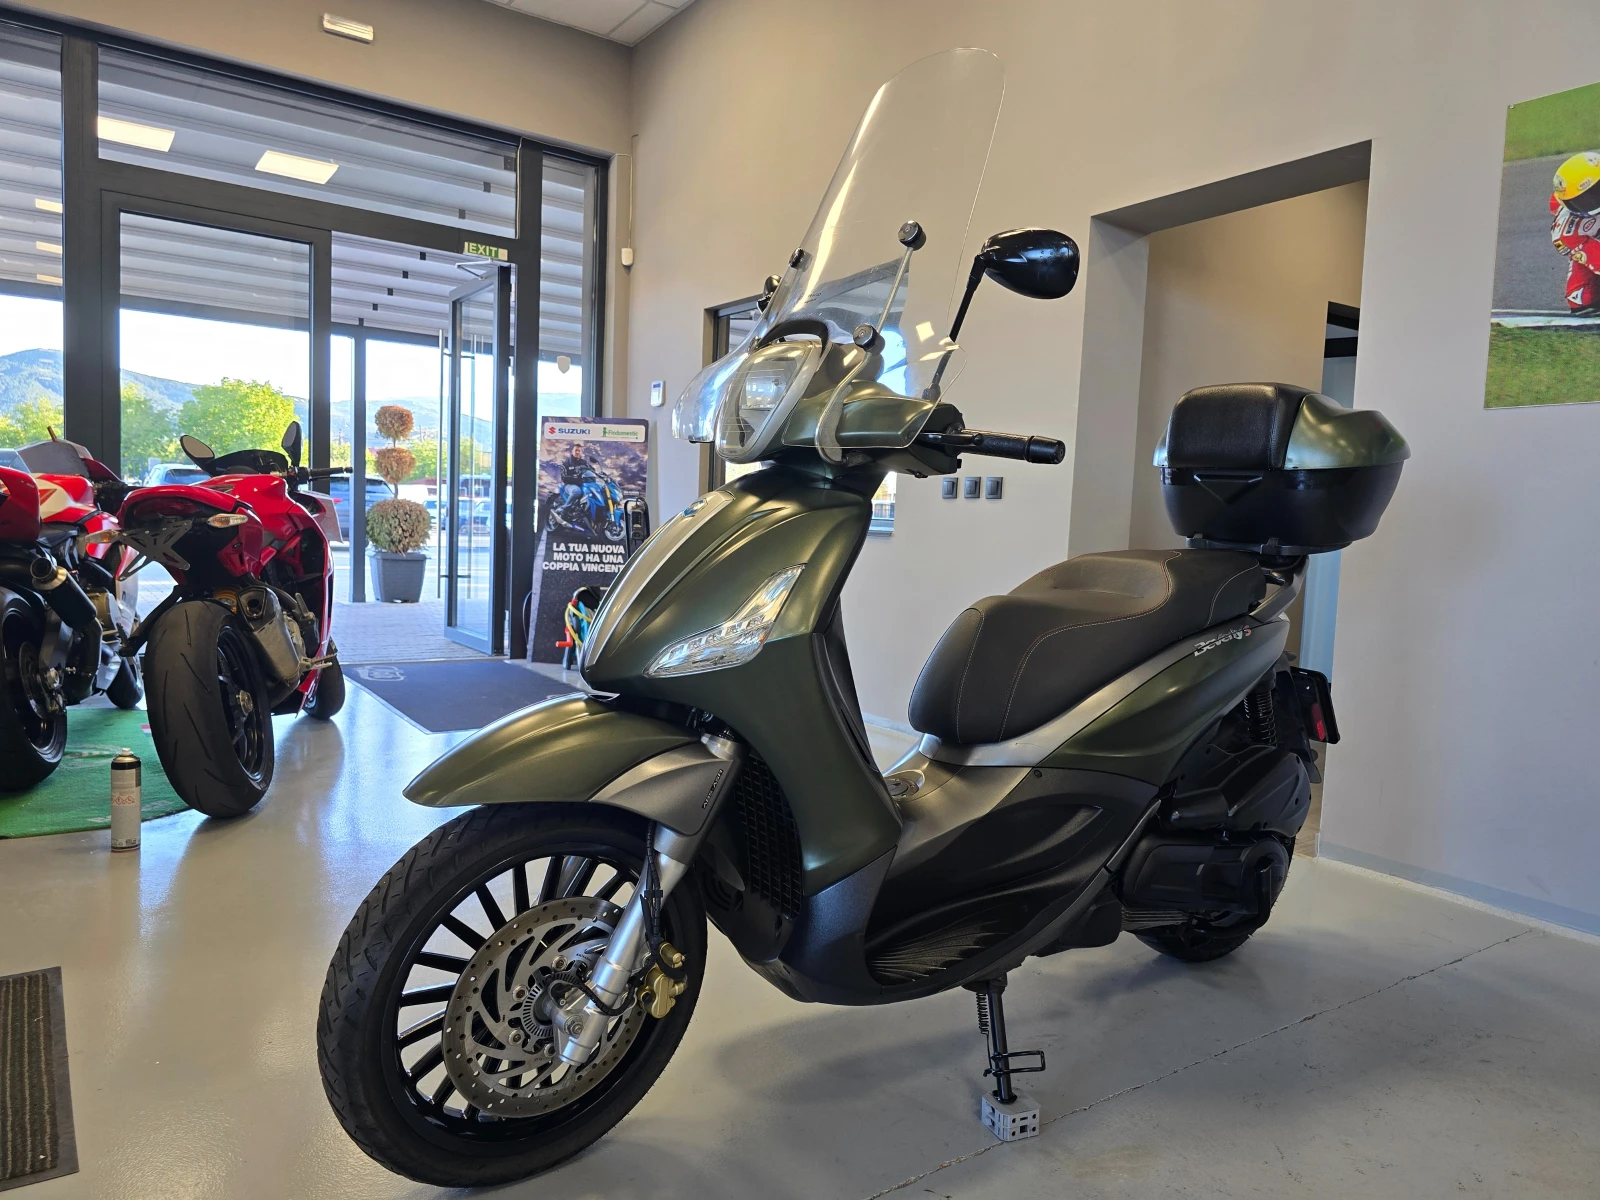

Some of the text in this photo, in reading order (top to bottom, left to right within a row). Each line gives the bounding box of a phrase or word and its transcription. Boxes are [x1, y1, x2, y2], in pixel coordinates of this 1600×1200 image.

[469, 242, 497, 257] EXIT
[558, 427, 590, 435] SUZUKI
[553, 543, 625, 554] LA TUA NUOVA
[553, 553, 624, 564] MOTO HA UNA
[542, 561, 580, 572] COPPIA
